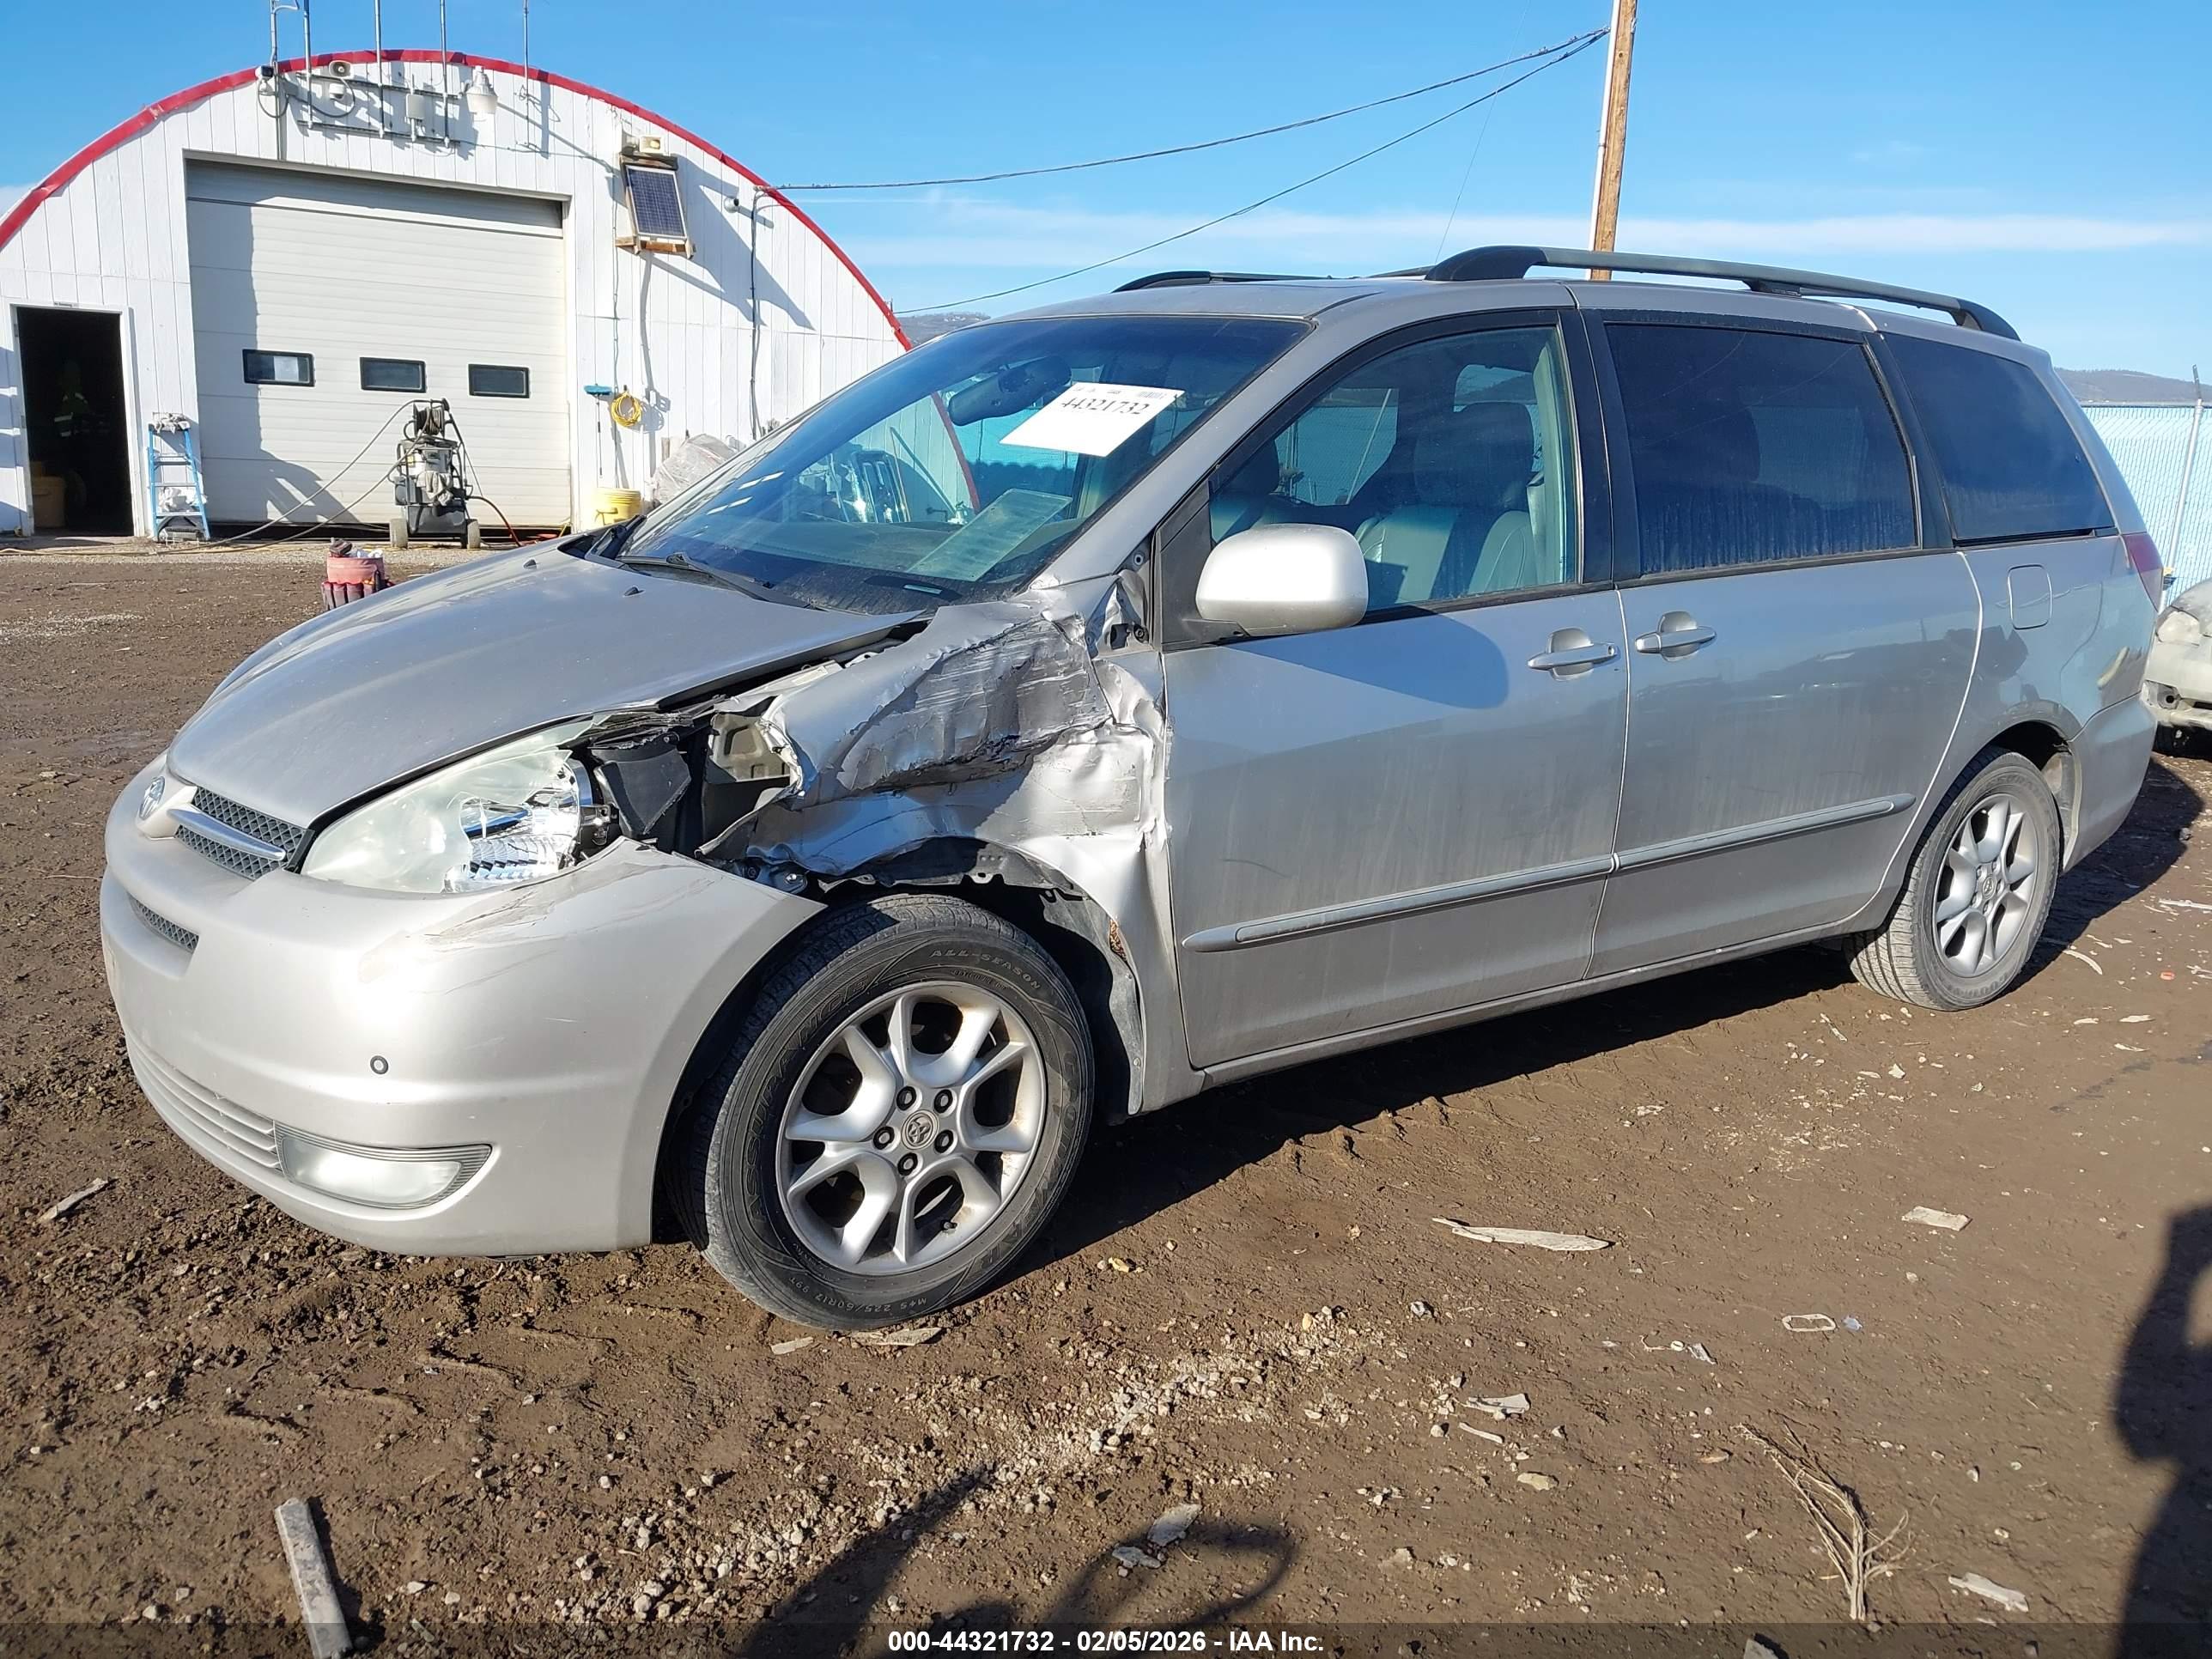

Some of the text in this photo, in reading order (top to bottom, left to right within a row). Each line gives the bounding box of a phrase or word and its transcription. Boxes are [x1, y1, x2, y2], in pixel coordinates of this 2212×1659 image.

[1061, 398, 1150, 415] 44321732
[928, 949, 1041, 990] ALL-SEASON
[787, 1277, 927, 1312] M+S 225/60R17 99T
